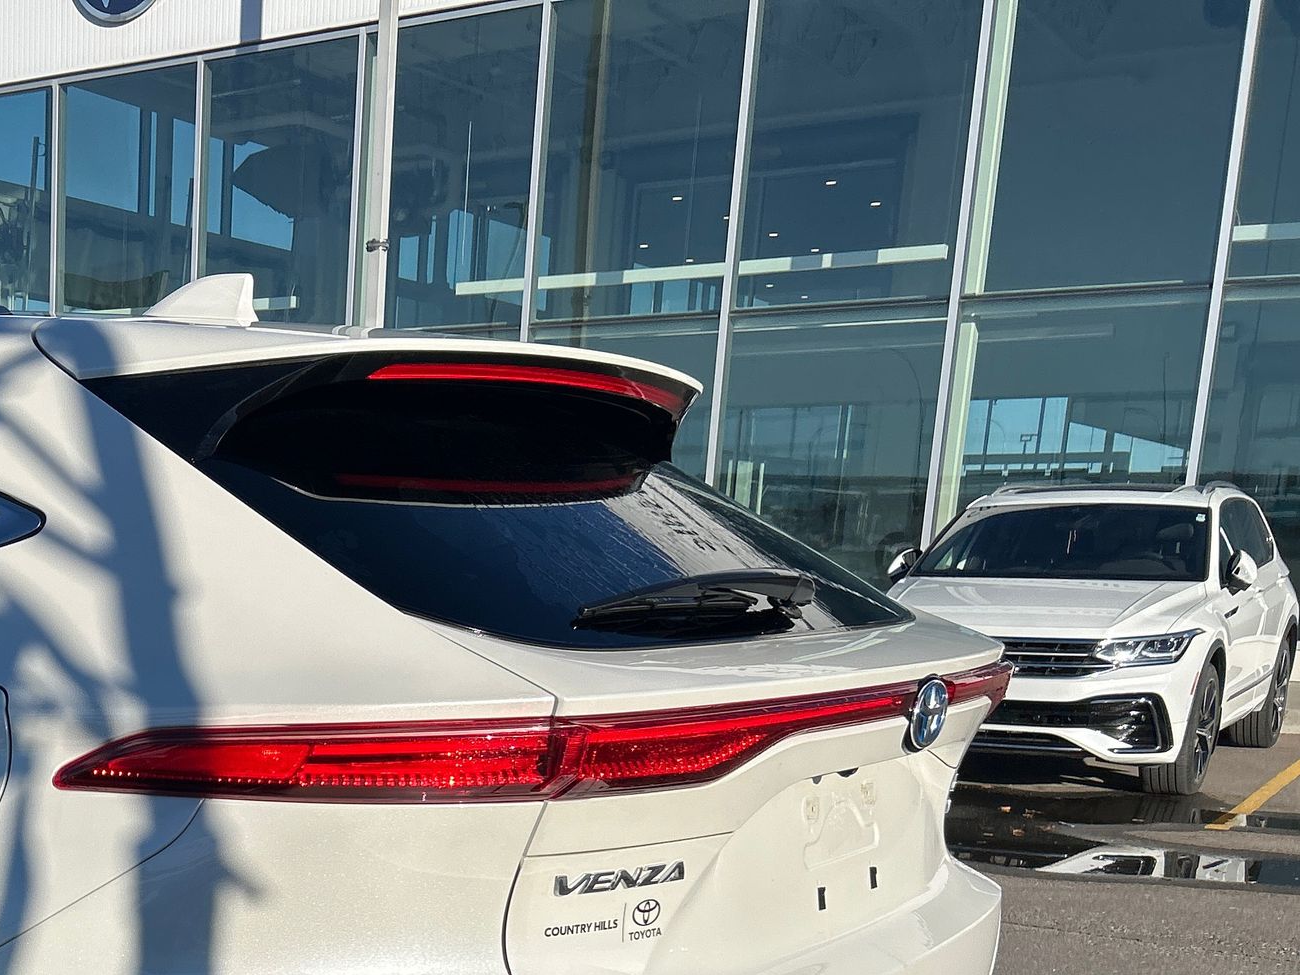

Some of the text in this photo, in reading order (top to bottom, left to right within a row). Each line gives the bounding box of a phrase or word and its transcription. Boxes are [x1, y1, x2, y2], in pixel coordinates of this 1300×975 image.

[553, 860, 685, 897] VENZA
[544, 918, 619, 938] COUNTRY HILLS
[628, 927, 662, 941] TOYOTA
